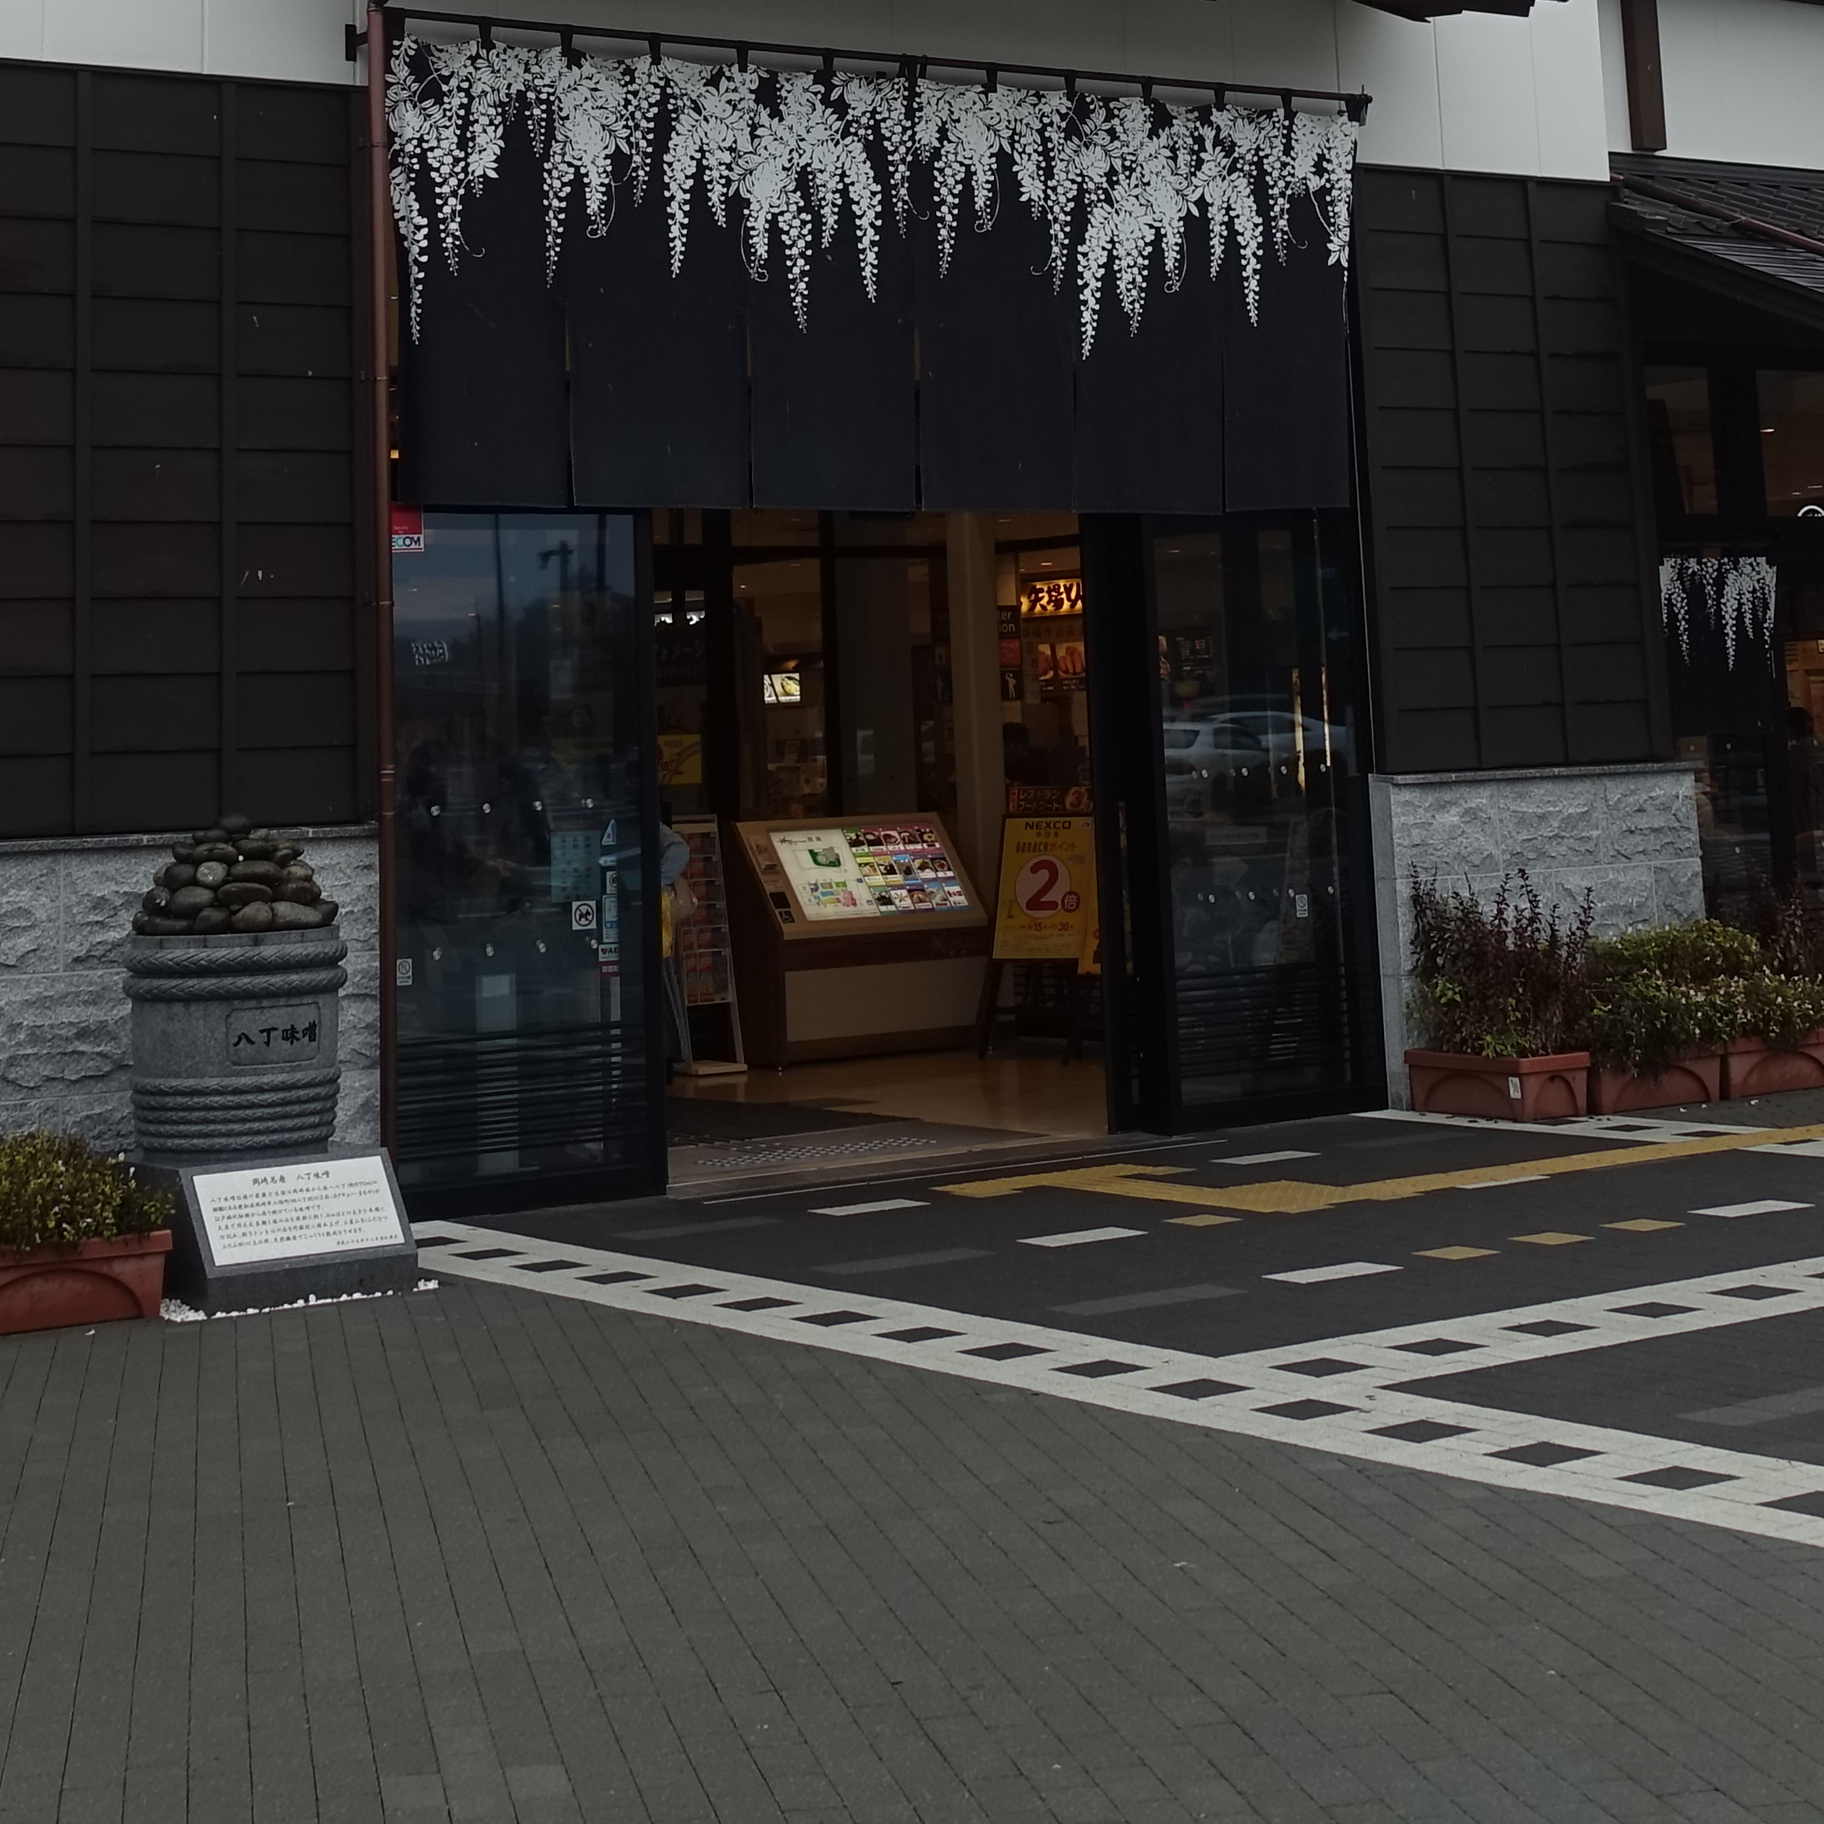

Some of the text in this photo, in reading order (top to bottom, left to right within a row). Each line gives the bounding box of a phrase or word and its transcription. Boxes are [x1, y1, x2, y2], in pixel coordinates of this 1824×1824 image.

[391, 536, 421, 547] ECOM
[1024, 820, 1072, 831] NEXCO
[232, 1019, 318, 1048] 八丁味噌
